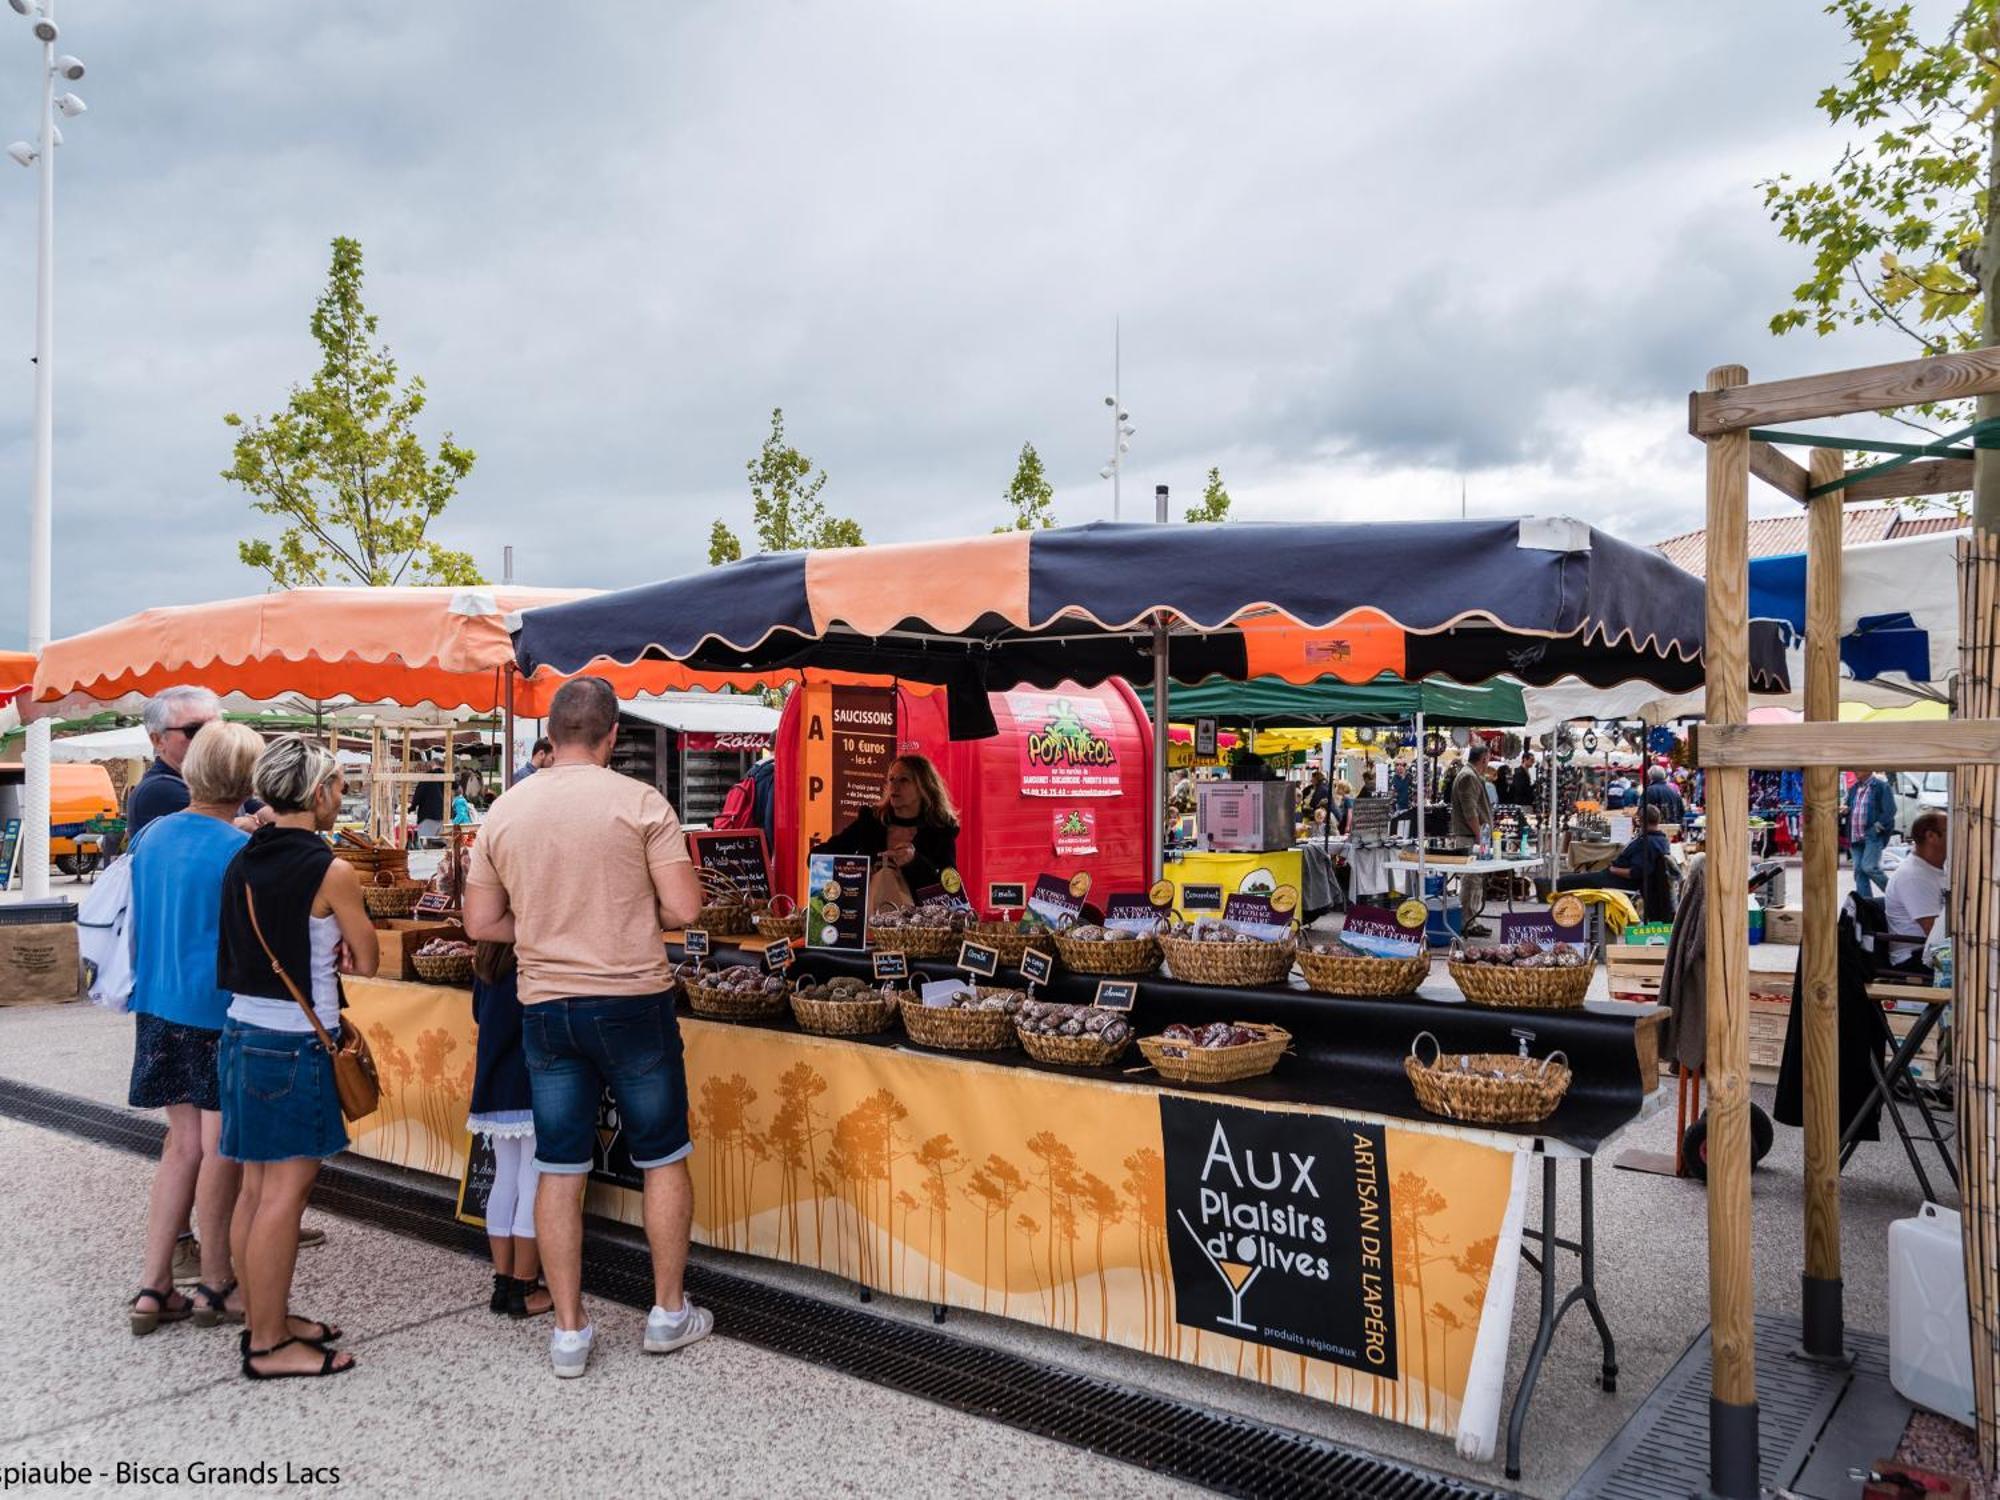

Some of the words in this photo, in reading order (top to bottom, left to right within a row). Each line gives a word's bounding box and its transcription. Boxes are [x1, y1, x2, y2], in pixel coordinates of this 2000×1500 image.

[834, 708, 894, 726] SAUCISSONS
[842, 738, 854, 752] 10
[855, 754, 866, 765] les
[867, 756, 873, 766] 4
[1350, 918, 1396, 932] SAUCISSON
[1363, 927, 1417, 943] BEAUFORT
[1352, 1132, 1380, 1231] ARTISAN
[1200, 1188, 1327, 1243] Plaisirs
[1361, 1235, 1381, 1270] DE
[1362, 1272, 1389, 1365] L'APÉRO
[1264, 1327, 1305, 1345] produits
[1306, 1338, 1358, 1359] régionaux
